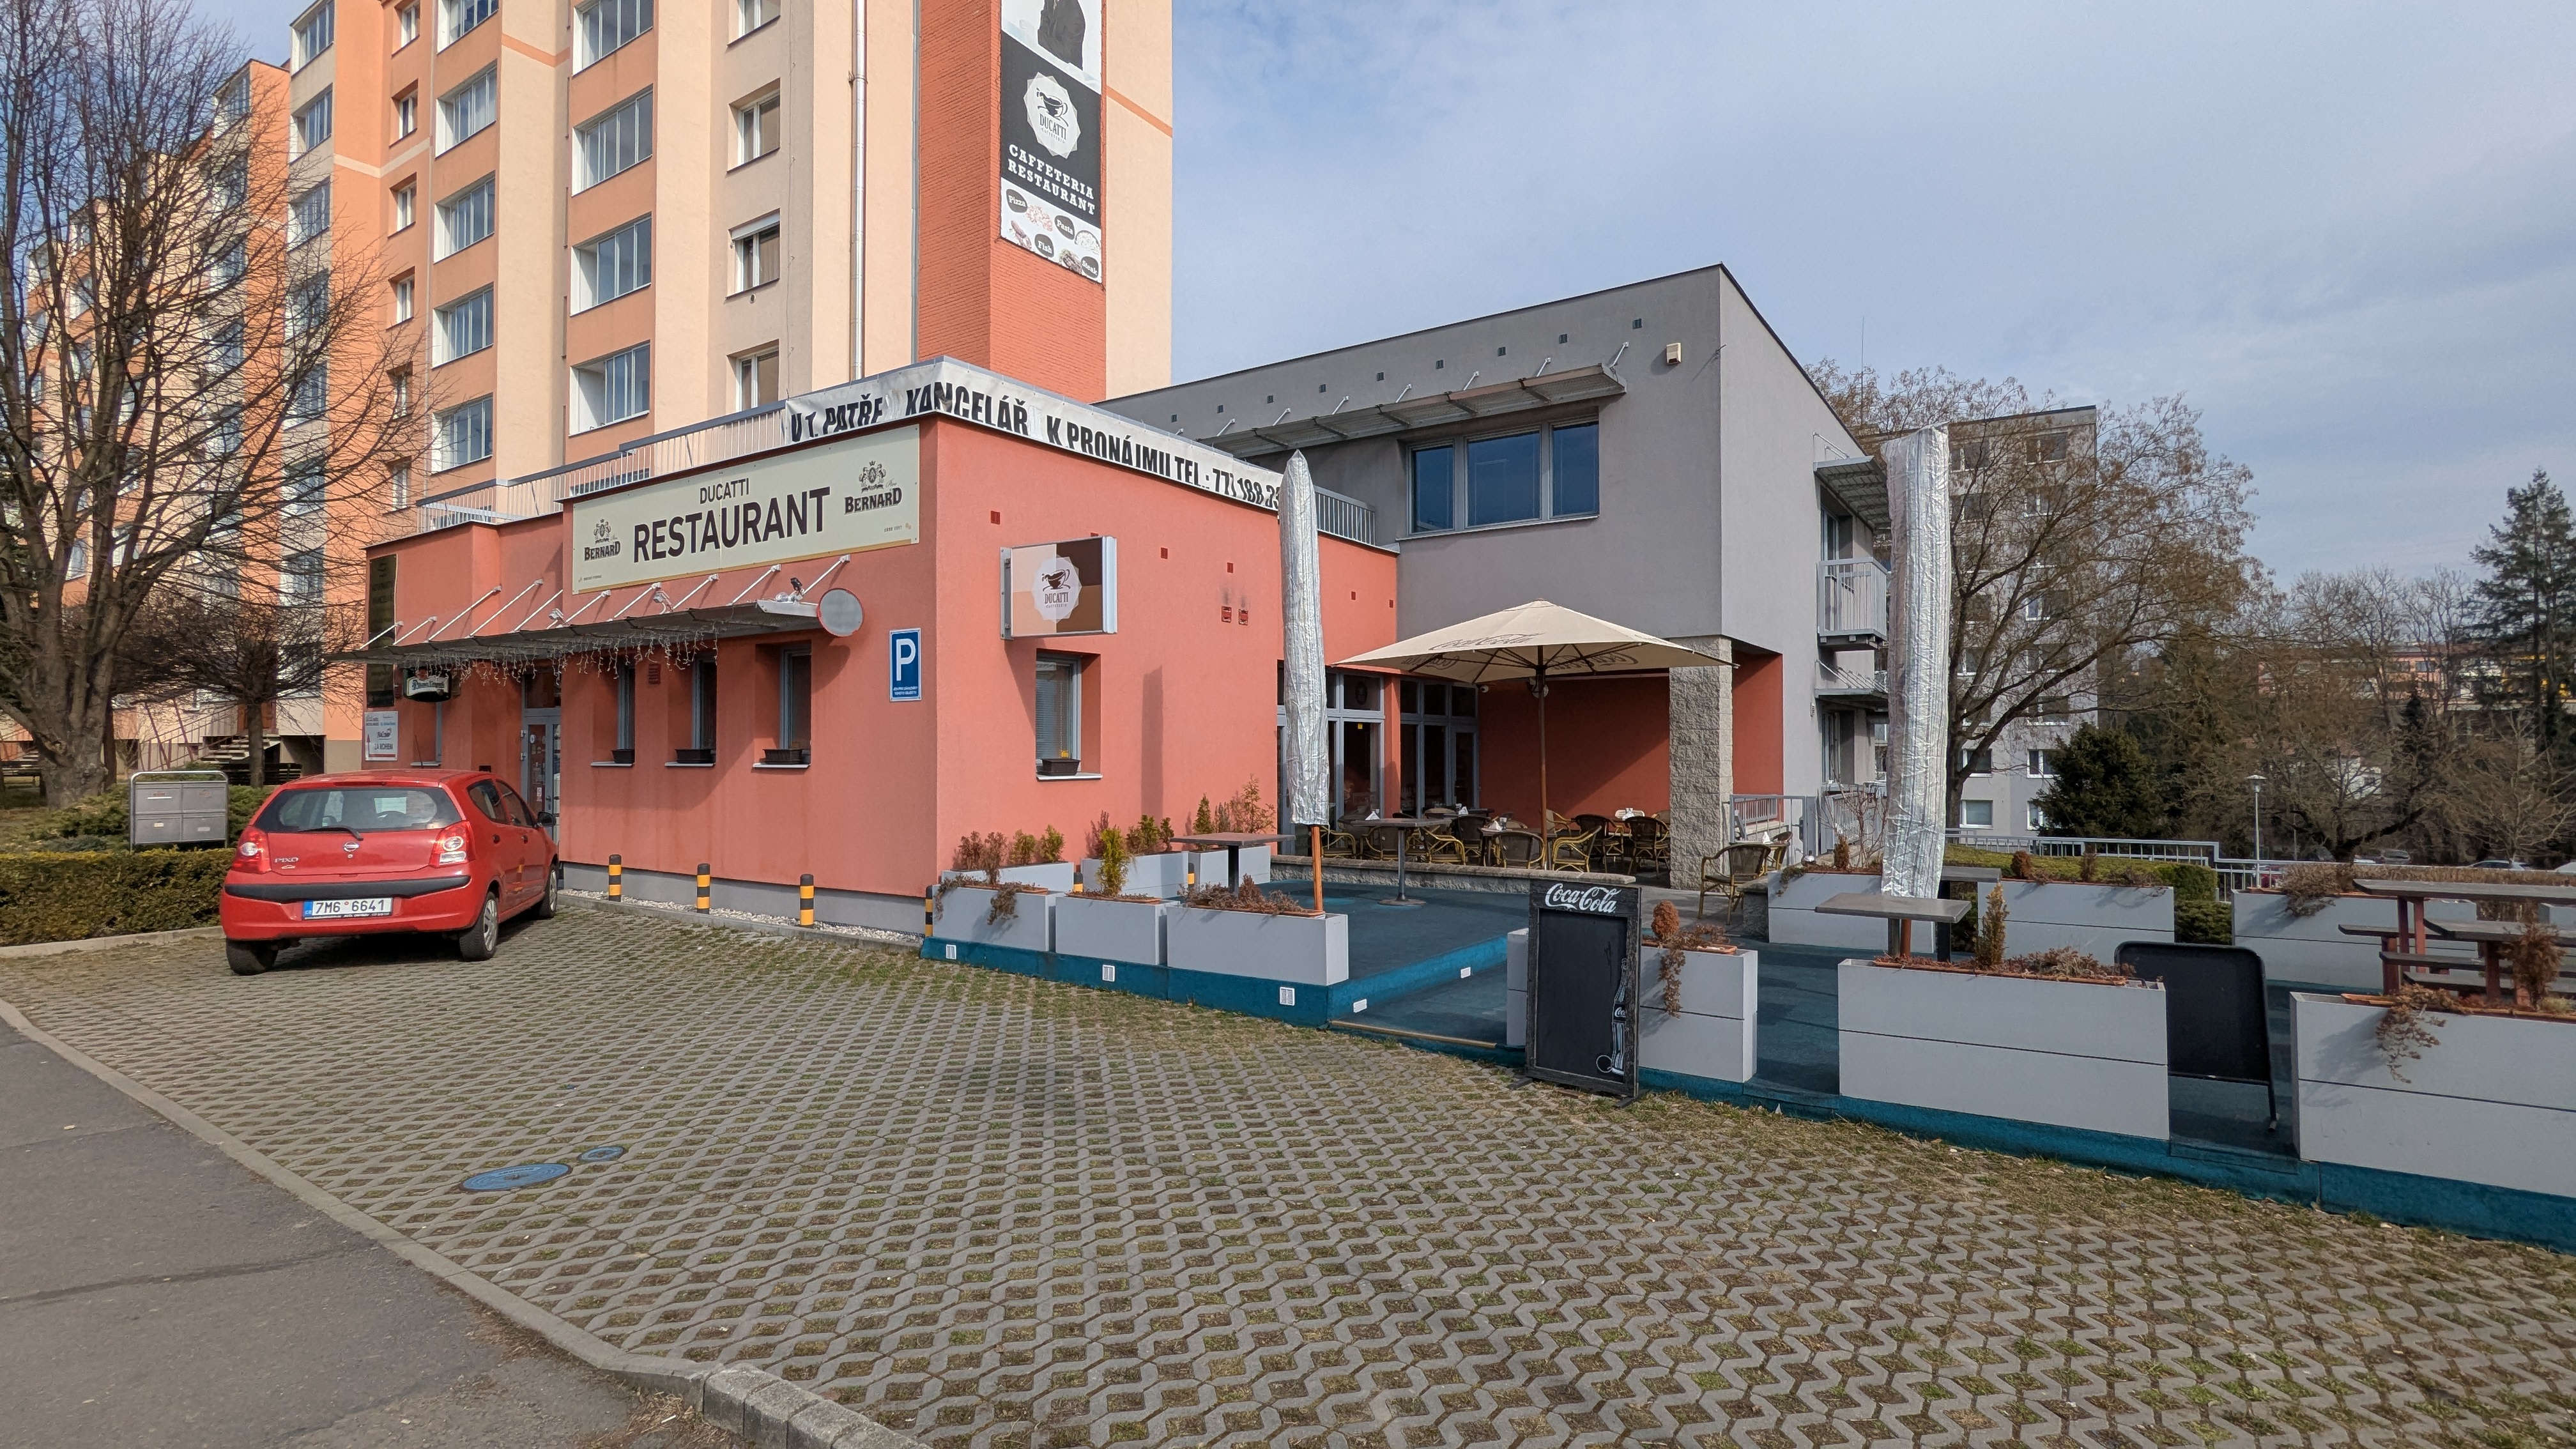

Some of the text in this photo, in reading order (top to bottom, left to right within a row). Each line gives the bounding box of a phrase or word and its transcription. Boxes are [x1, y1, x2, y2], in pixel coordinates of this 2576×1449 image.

[1039, 114, 1066, 140] DUCATTI
[1009, 144, 1094, 200] CAFFETERIA
[1008, 158, 1096, 215] RESTAURANT
[1008, 195, 1026, 208] Pizza
[1056, 218, 1074, 236] Pasta
[1038, 240, 1053, 254] Fish
[1082, 260, 1098, 276] Steak
[905, 381, 1029, 436] KANCELÁŘ
[1046, 415, 1063, 446] K
[700, 477, 749, 505] DUCATTI
[844, 487, 902, 515] BERNARD
[634, 486, 831, 563] RESTAURANT
[584, 540, 621, 562] BERNARD
[1045, 592, 1069, 604] DUCATTI
[896, 638, 916, 681] P
[316, 901, 341, 914] 7M6
[351, 900, 385, 911] 6641
[1545, 883, 1621, 913] Coca-Cola
